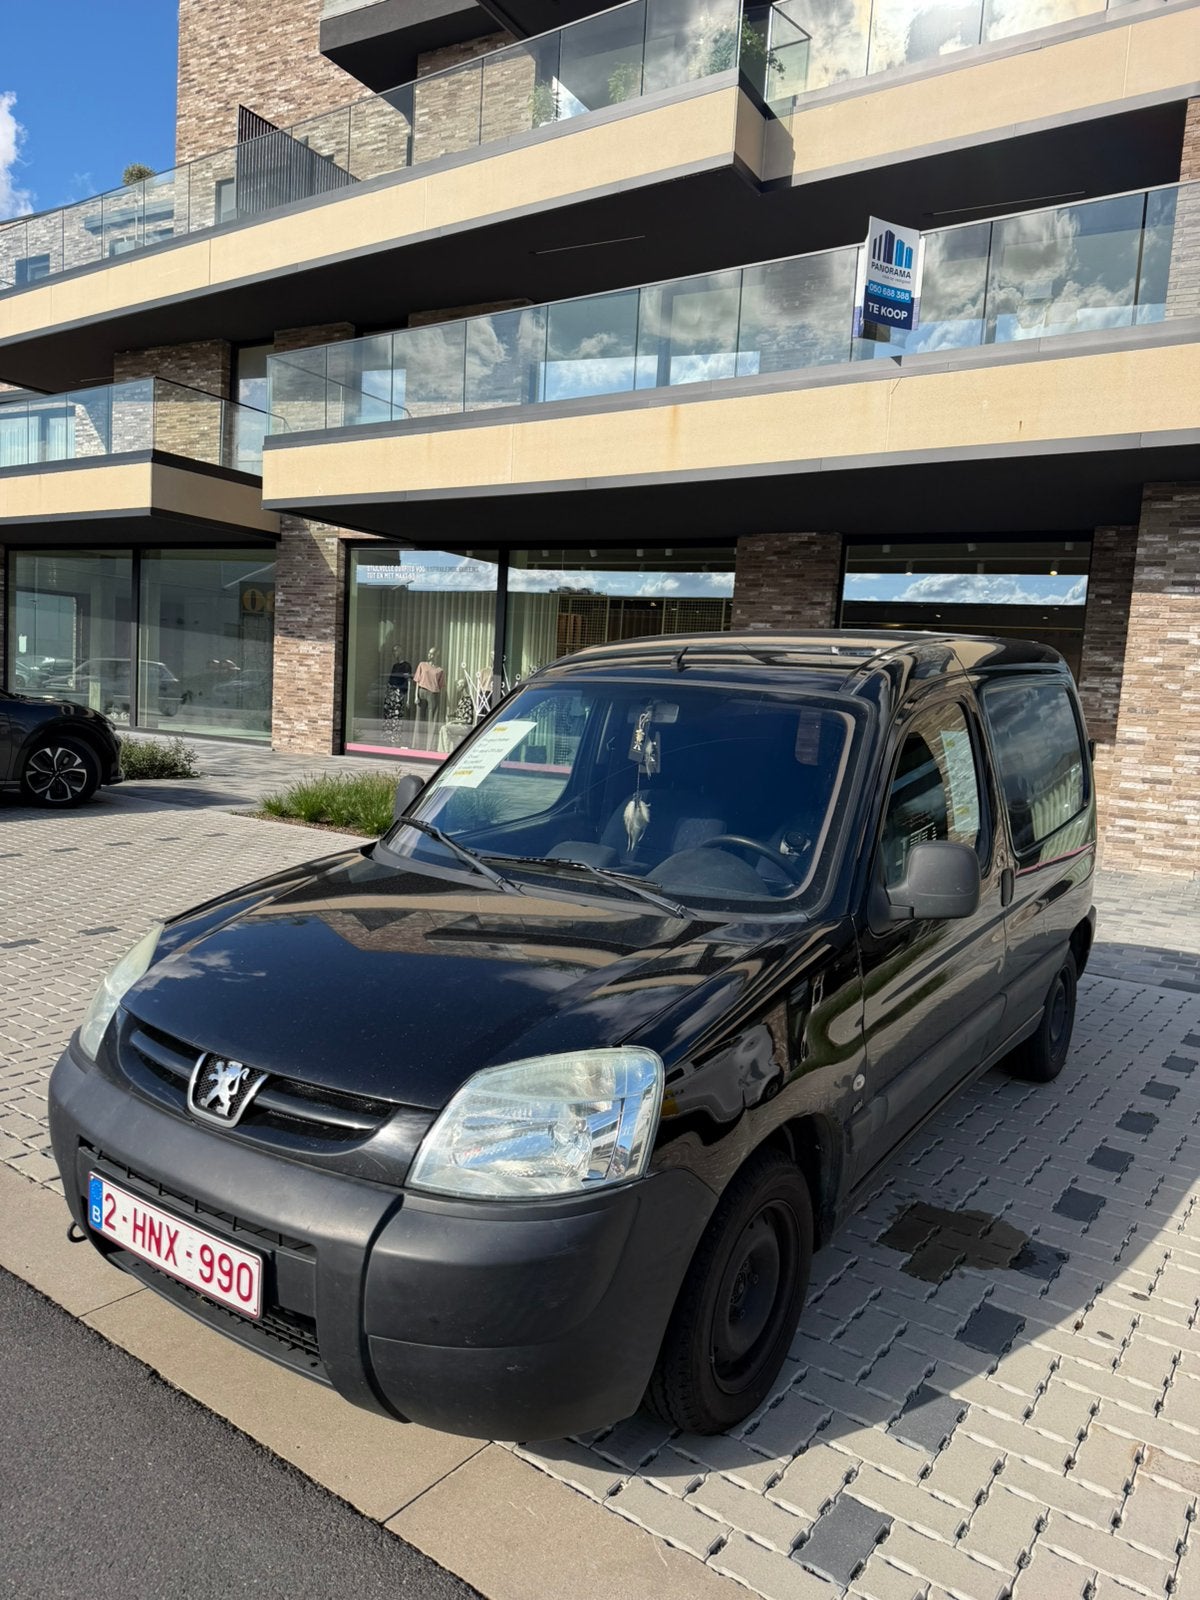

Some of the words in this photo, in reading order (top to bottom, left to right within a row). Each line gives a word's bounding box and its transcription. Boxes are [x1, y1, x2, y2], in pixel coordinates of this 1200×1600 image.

[871, 261, 911, 279] PANORAMA
[869, 283, 881, 294] 050
[896, 290, 909, 300] 388
[868, 302, 879, 314] TE
[880, 307, 908, 320] KOOP
[91, 1205, 101, 1223] B
[104, 1192, 254, 1303] 2-HNX-990
